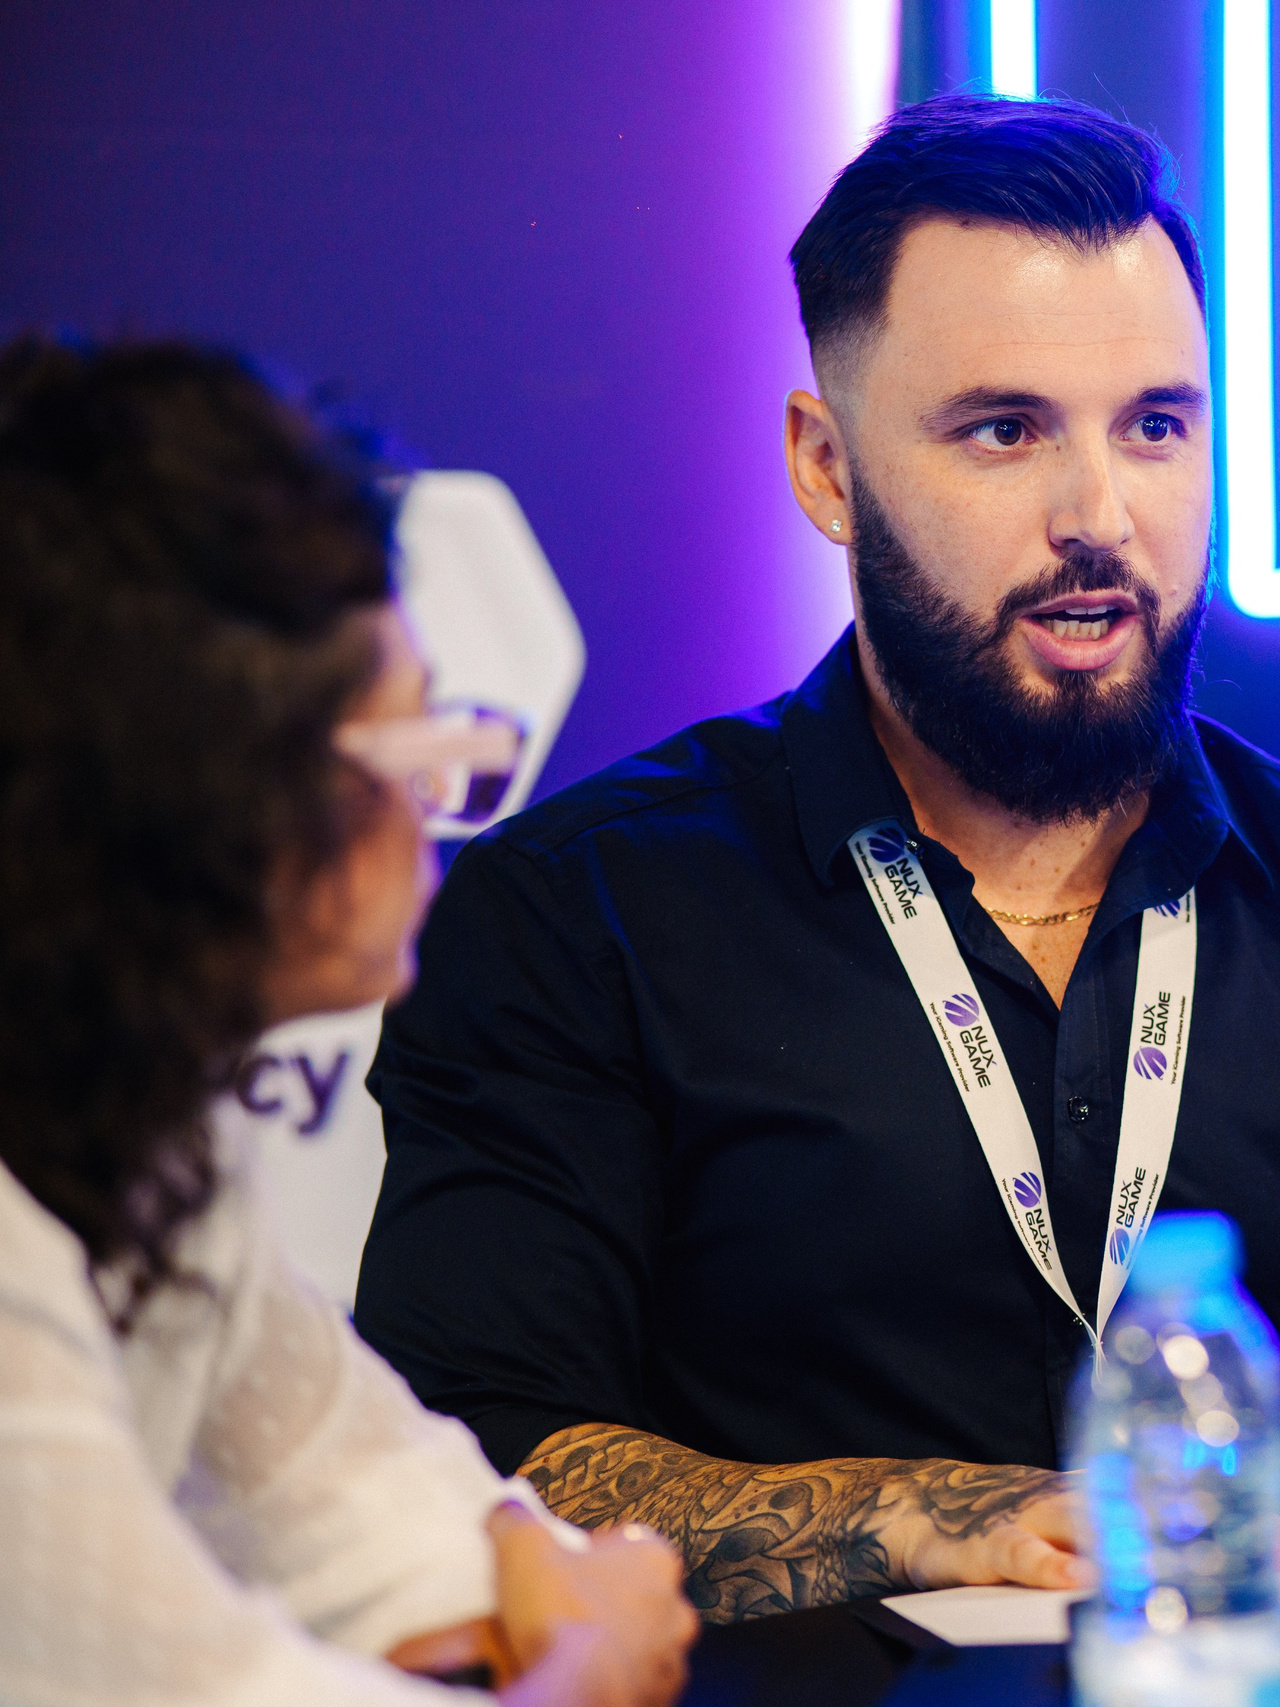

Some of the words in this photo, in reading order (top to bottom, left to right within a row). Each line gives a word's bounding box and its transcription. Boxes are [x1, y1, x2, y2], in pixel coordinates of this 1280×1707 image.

[871, 878, 885, 902] Software
[883, 902, 896, 925] Provider
[884, 864, 918, 919] GAME
[896, 857, 921, 899] NUX
[1140, 1003, 1156, 1044] NUX
[1154, 991, 1171, 1046] GAME
[1176, 1020, 1184, 1045] Software
[936, 1015, 949, 1040] iGaming
[946, 1040, 960, 1067] Software
[957, 1067, 970, 1092] Provider
[960, 1030, 991, 1088] GAME
[971, 1025, 997, 1069] NUX
[1116, 1180, 1132, 1225] NUX
[1124, 1167, 1146, 1228] GAME
[1140, 1201, 1152, 1228] Software
[1149, 1173, 1159, 1200] Provider
[1025, 1211, 1053, 1271] GAME
[1033, 1208, 1052, 1253] NUX
